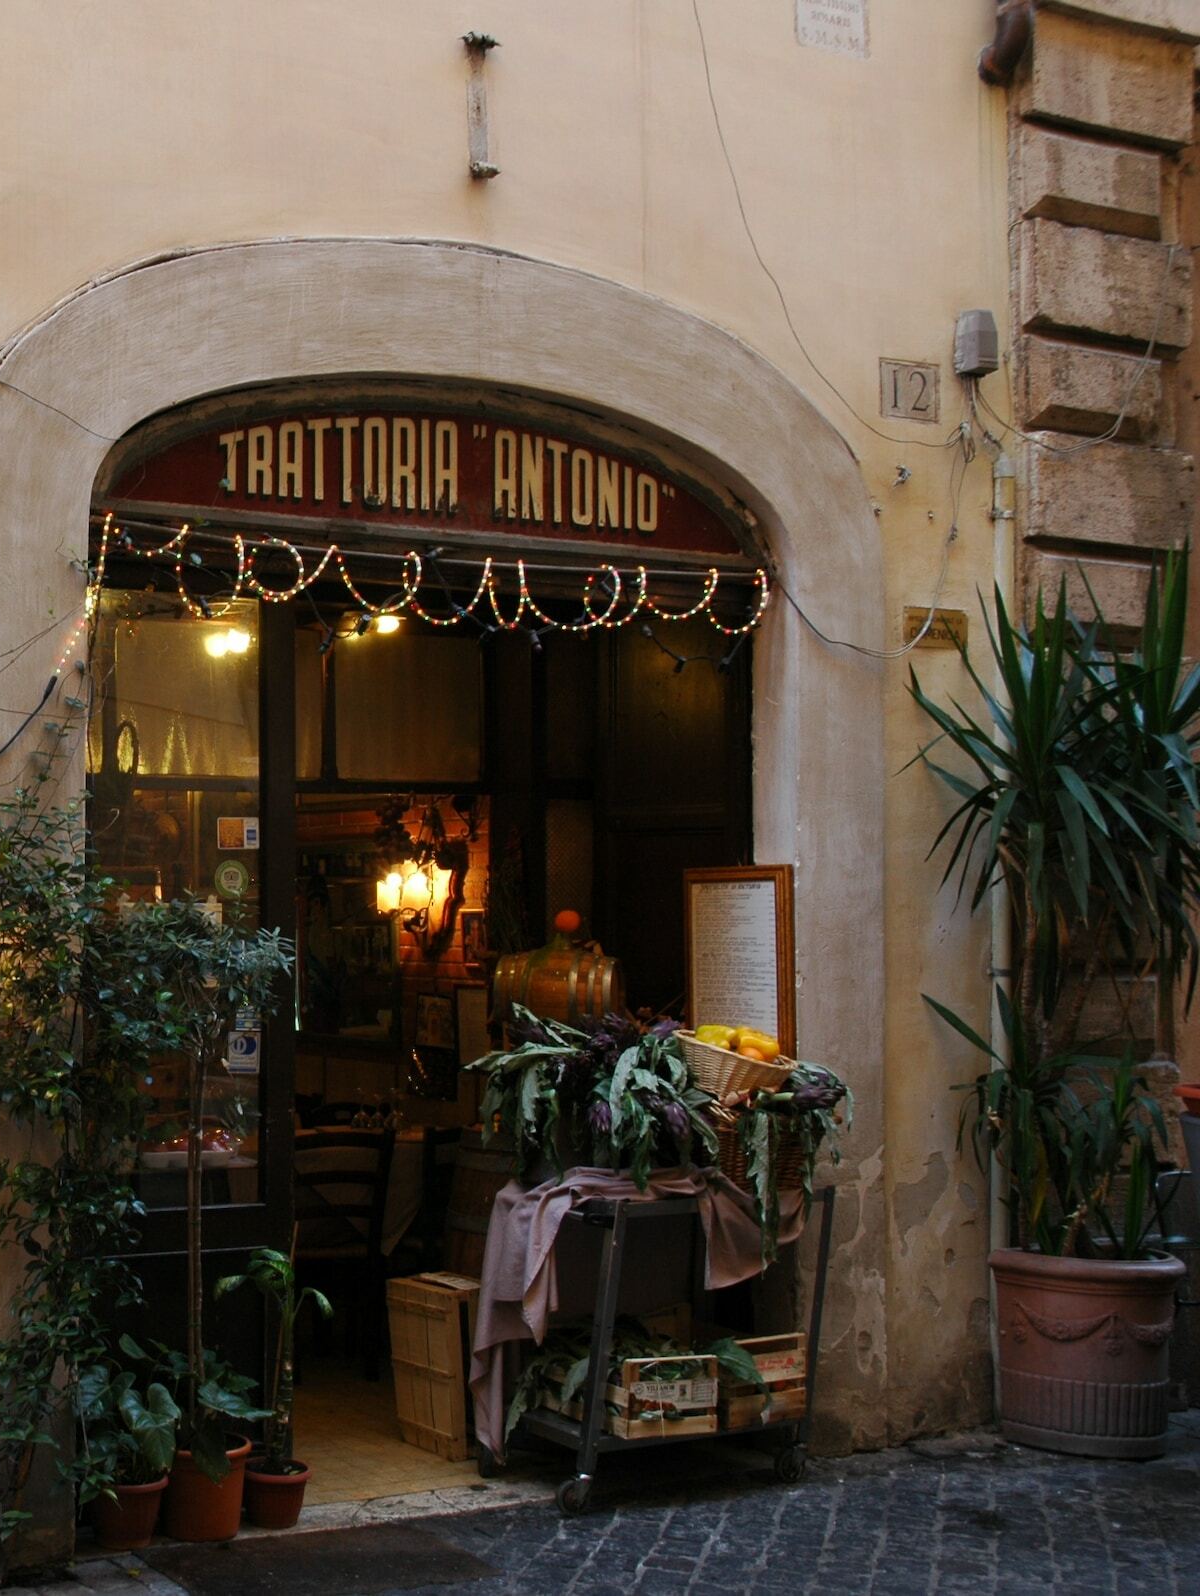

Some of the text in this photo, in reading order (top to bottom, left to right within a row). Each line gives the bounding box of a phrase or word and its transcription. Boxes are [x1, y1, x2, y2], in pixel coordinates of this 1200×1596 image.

[891, 369, 931, 412] 12
[219, 416, 675, 532] TRATTORIA "ANTONIO"
